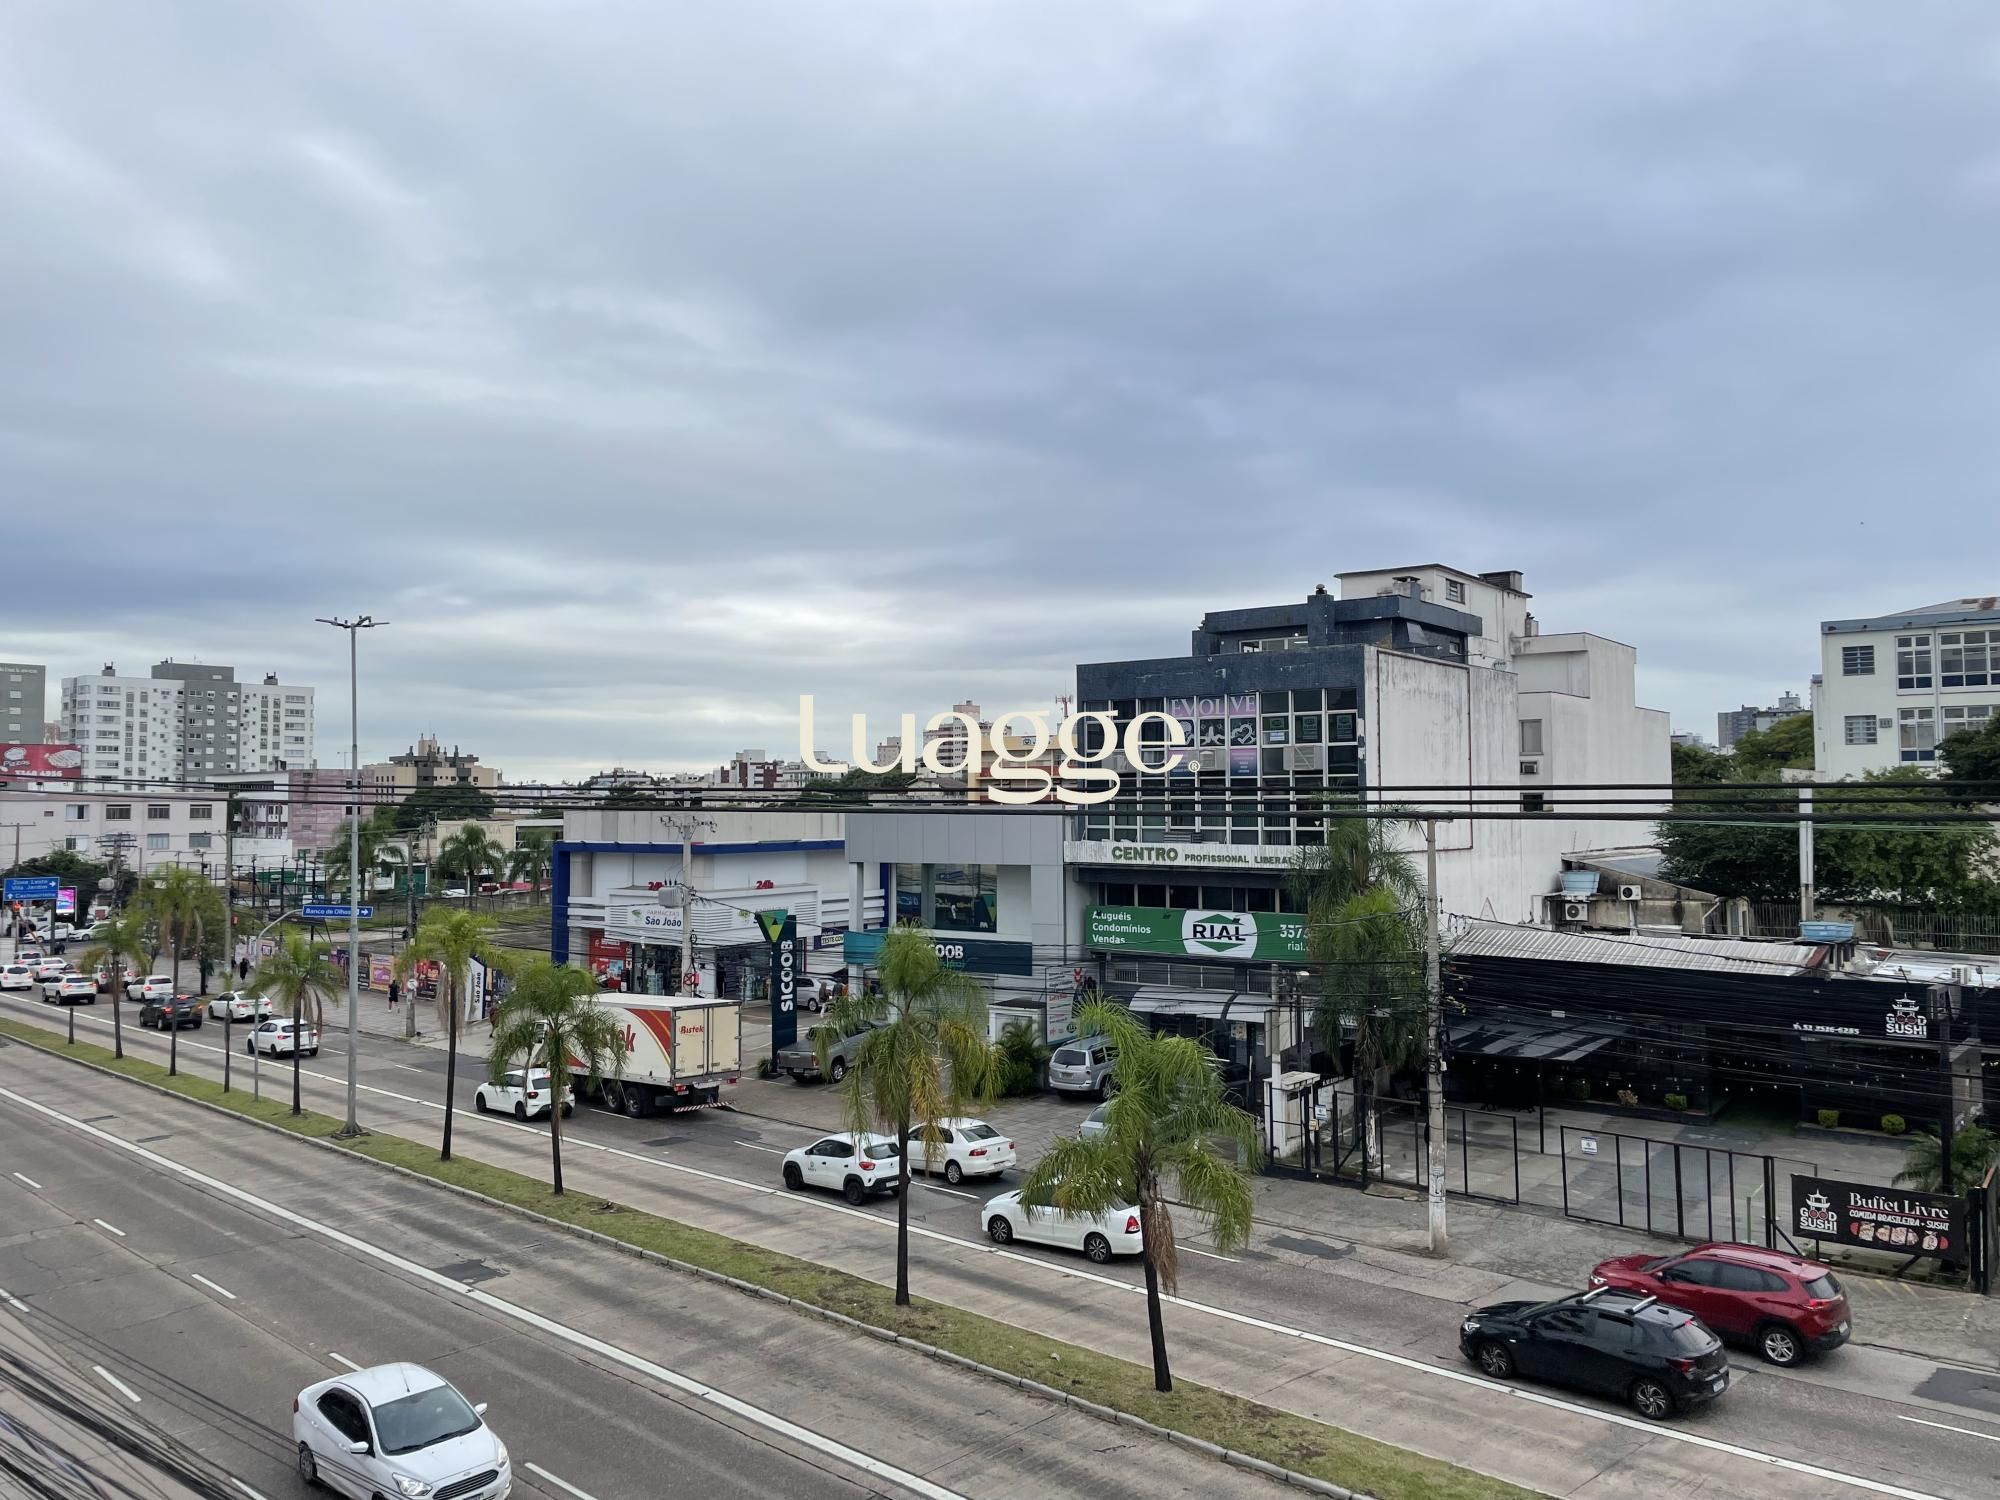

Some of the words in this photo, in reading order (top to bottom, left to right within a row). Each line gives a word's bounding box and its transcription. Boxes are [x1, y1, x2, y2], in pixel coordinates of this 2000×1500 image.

[1171, 695, 1256, 717] EVOLVE
[1111, 846, 1178, 862] CENTRO
[1184, 854, 1249, 864] PROFISSIONAL
[1254, 855, 1294, 865] LIBERAL
[1092, 911, 1132, 921] Auguéis
[1092, 922, 1151, 934] Condomínios
[1192, 923, 1246, 942] RIAL
[1092, 934, 1126, 944] Vendas
[780, 939, 794, 1012] SICOOB
[1886, 1013, 1927, 1026] GOOD
[1886, 1023, 1927, 1035] SUSHI
[1849, 1192, 1900, 1212] Buffet
[1904, 1200, 1949, 1219] Livre
[1800, 1207, 1838, 1221] GOOD
[1849, 1209, 1877, 1221] COMIDA
[1877, 1213, 1920, 1227] BRASILEIRA
[1926, 1220, 1950, 1231] SUSHI
[1800, 1216, 1838, 1230] SUSHI
